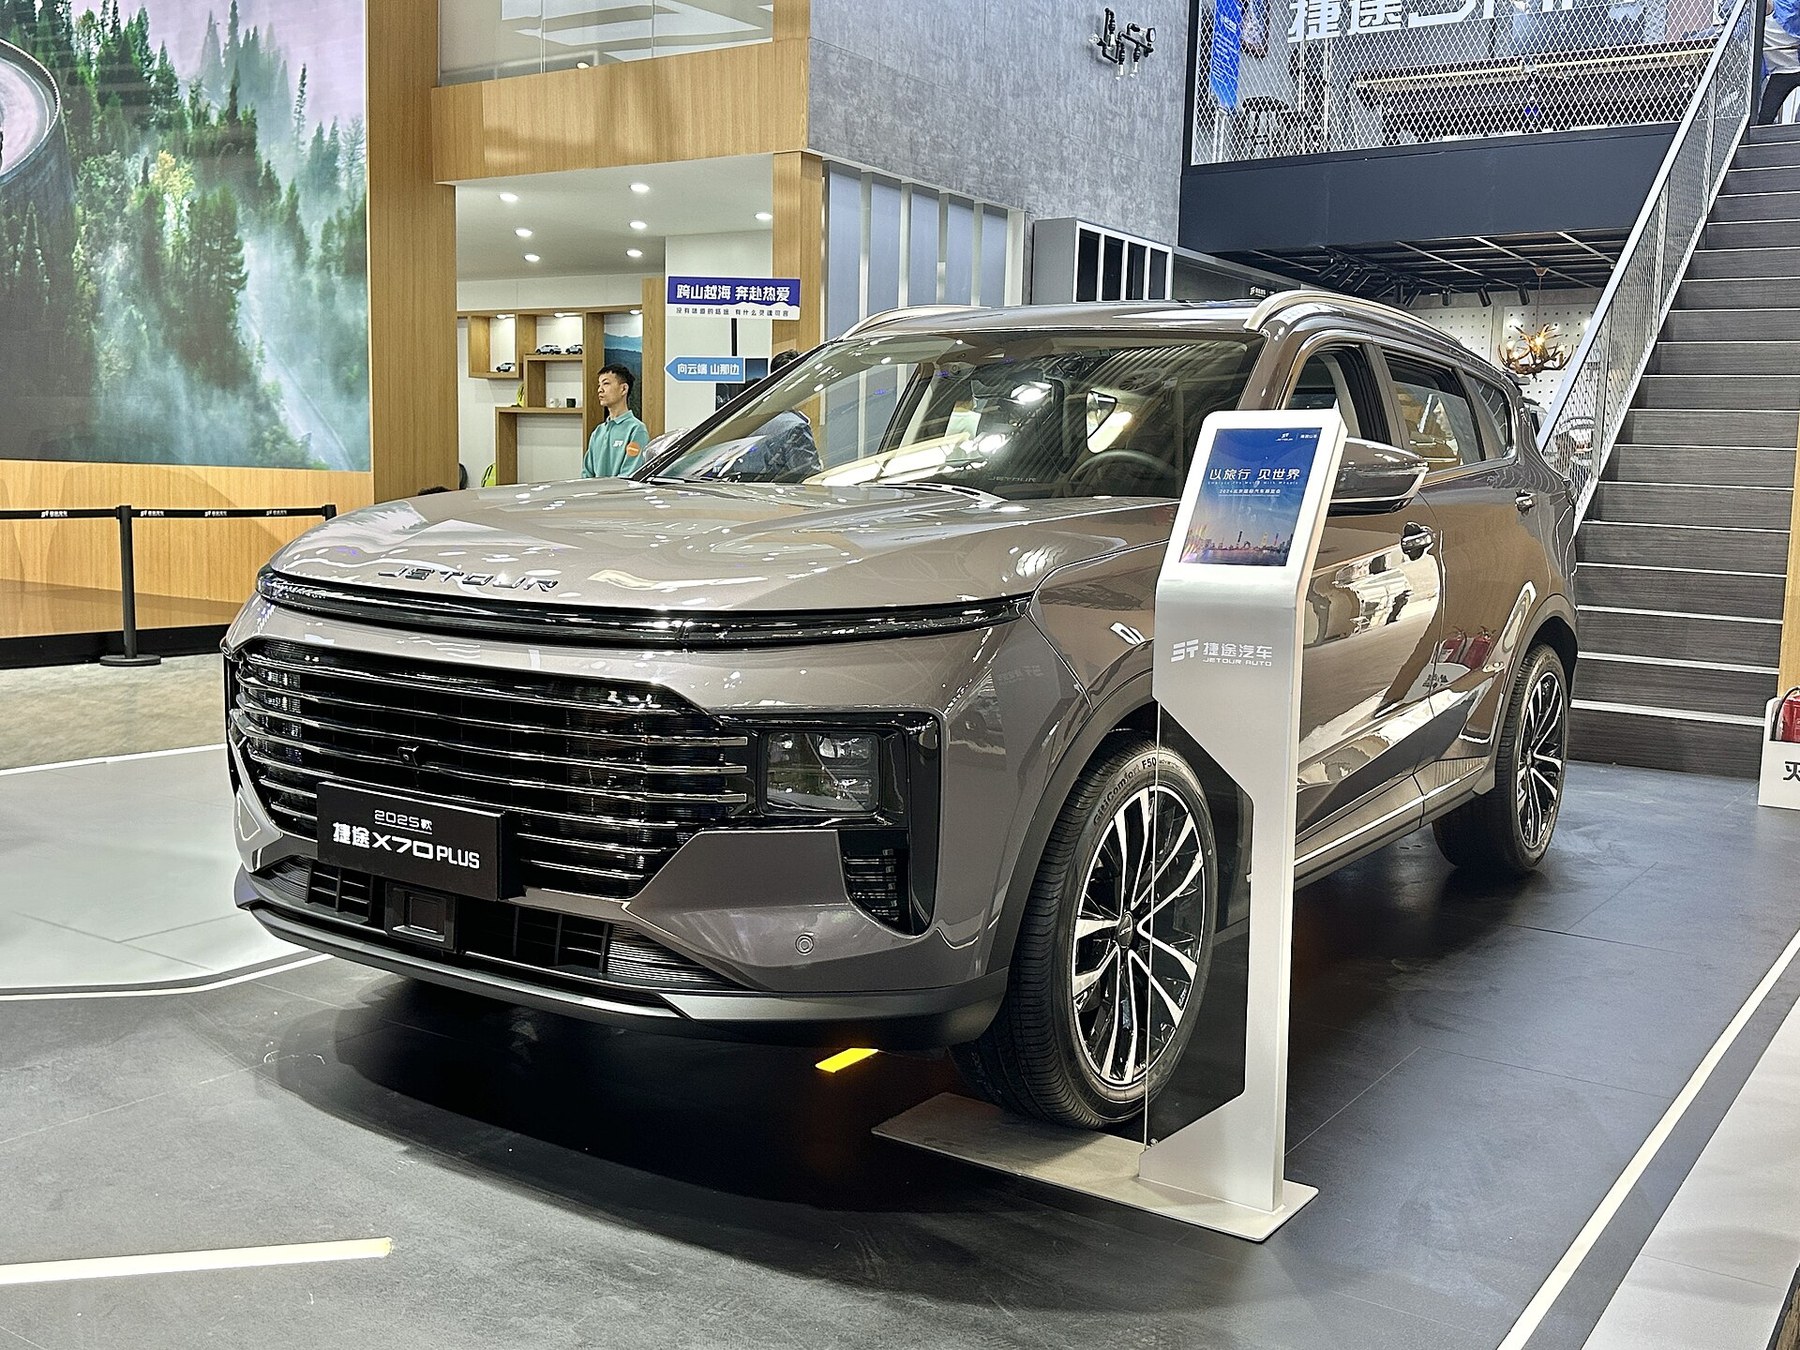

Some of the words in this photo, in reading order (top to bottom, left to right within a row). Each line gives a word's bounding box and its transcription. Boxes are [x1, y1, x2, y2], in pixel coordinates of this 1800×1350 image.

[676, 284, 732, 300] 跨山越海
[735, 286, 790, 301] 奔赴热爱
[710, 363, 740, 375] 山那边
[1209, 468, 1251, 480] 以旅行
[1257, 468, 1300, 480] 见世界
[378, 565, 559, 592] JETOUR
[1202, 641, 1273, 659] 捷途汽车
[1202, 657, 1242, 665] JETOUR
[1141, 757, 1157, 770] F50
[374, 809, 433, 831] 2025款
[436, 846, 480, 869] PLUS
